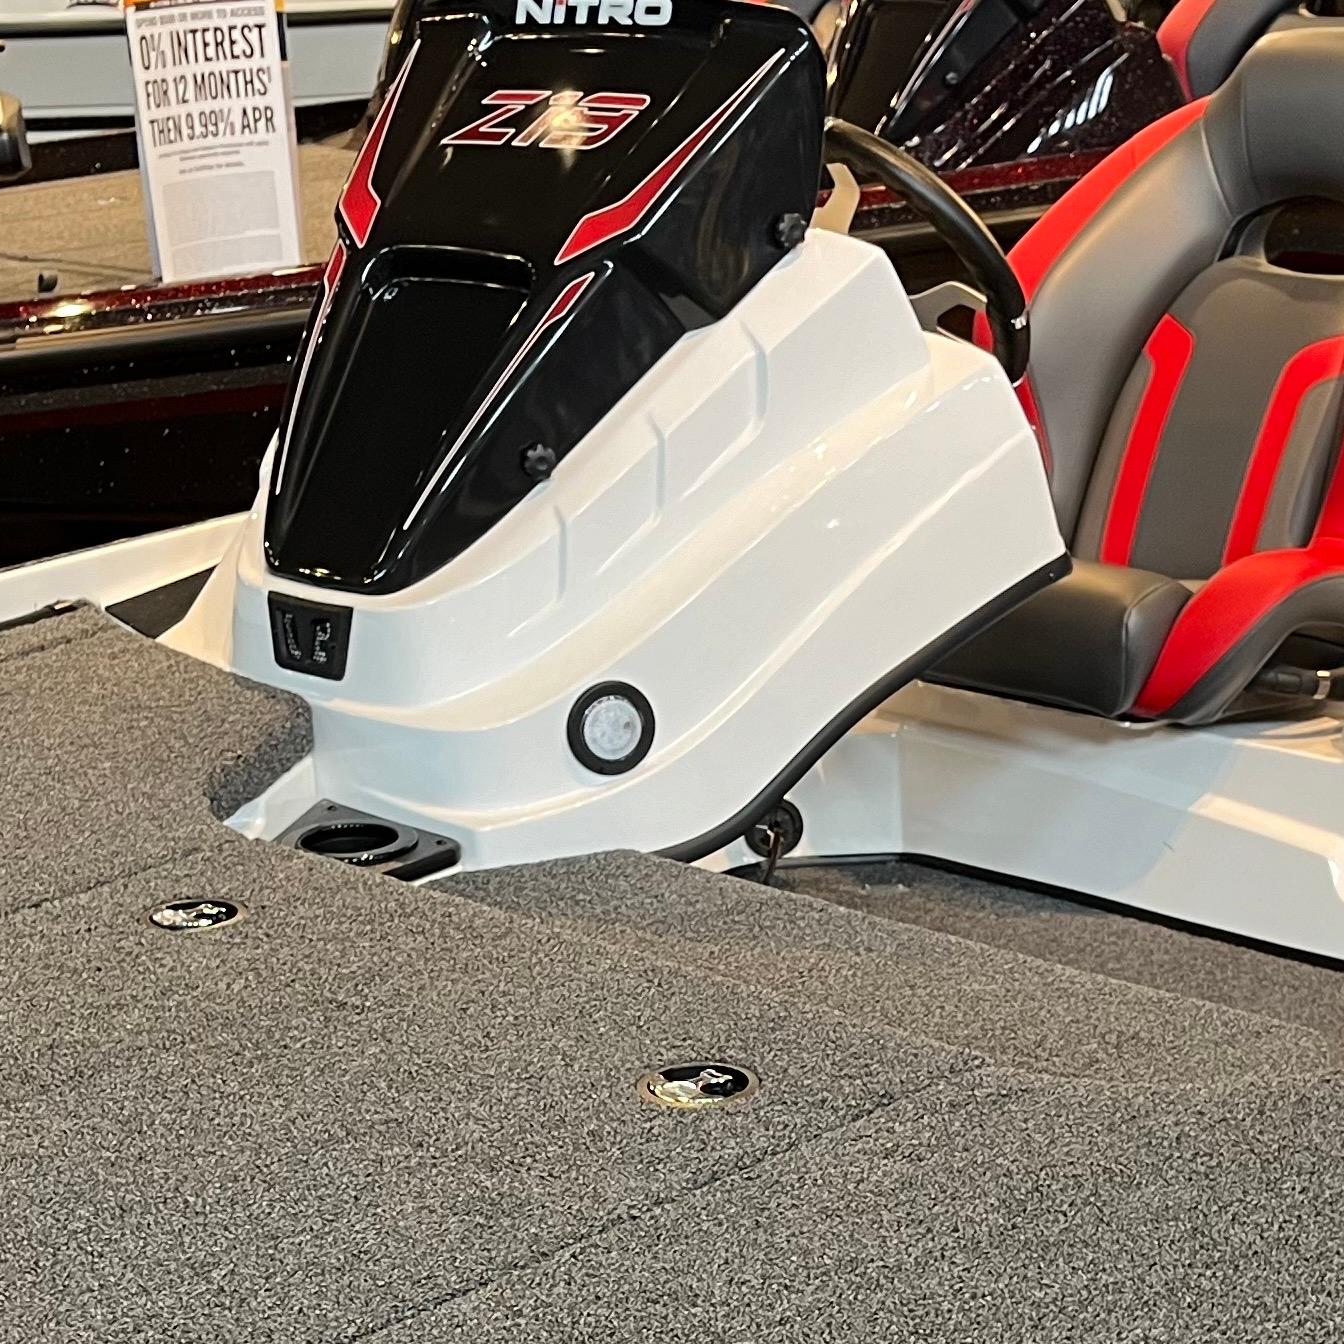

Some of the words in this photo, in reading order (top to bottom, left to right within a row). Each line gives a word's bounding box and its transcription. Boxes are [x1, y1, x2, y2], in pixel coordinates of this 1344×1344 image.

[139, 31, 167, 70] 0%
[170, 23, 267, 67] INTEREST
[144, 78, 171, 111] FOR
[173, 75, 189, 105] 12
[149, 114, 183, 148] THEN
[185, 107, 236, 142] 9.99%
[240, 105, 276, 136] APR
[440, 89, 651, 150] Z19
